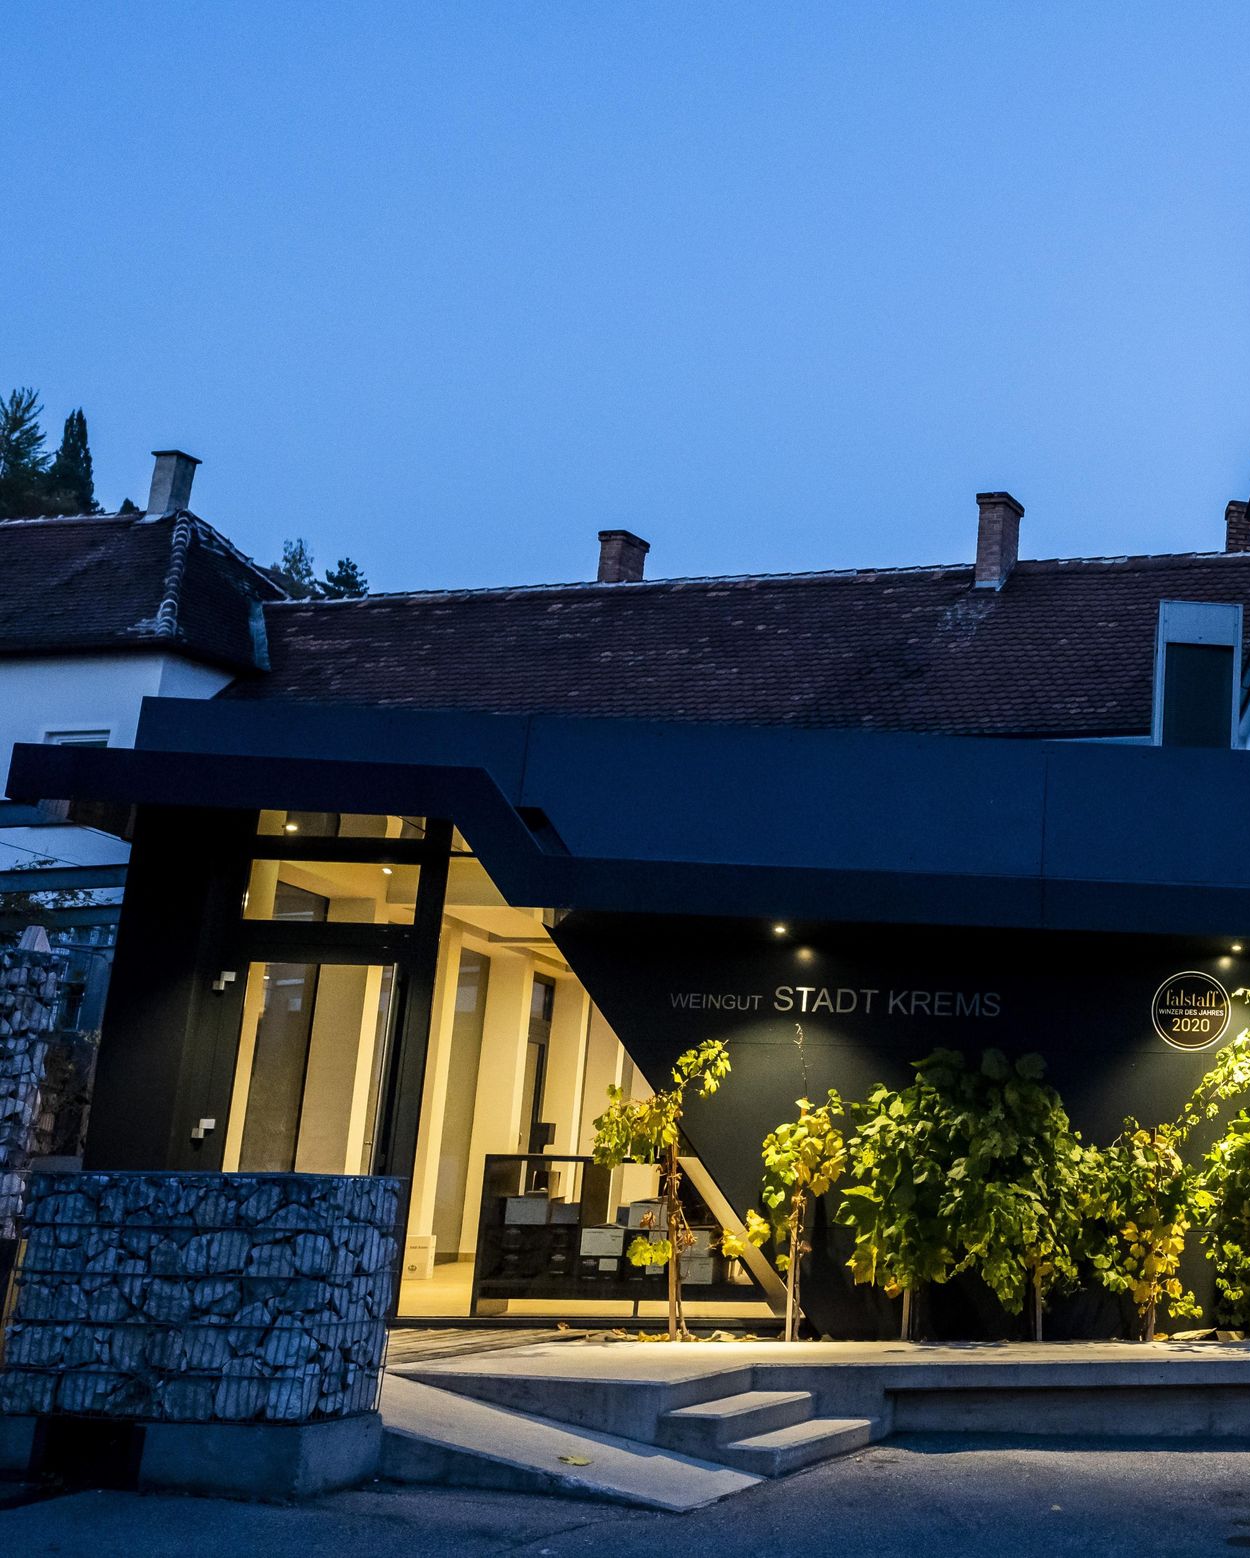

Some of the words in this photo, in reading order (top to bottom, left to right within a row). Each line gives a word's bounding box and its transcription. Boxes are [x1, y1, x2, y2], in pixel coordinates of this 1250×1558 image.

[669, 992, 764, 1011] WEINGUT
[773, 985, 880, 1014] STADT
[887, 990, 1001, 1017] KREMS
[1165, 989, 1219, 1008] falstaff
[1158, 1008, 1184, 1016] WINZER
[1184, 1008, 1198, 1016] DES
[1198, 1009, 1225, 1017] JAHRES
[1172, 1017, 1210, 1032] 2020
